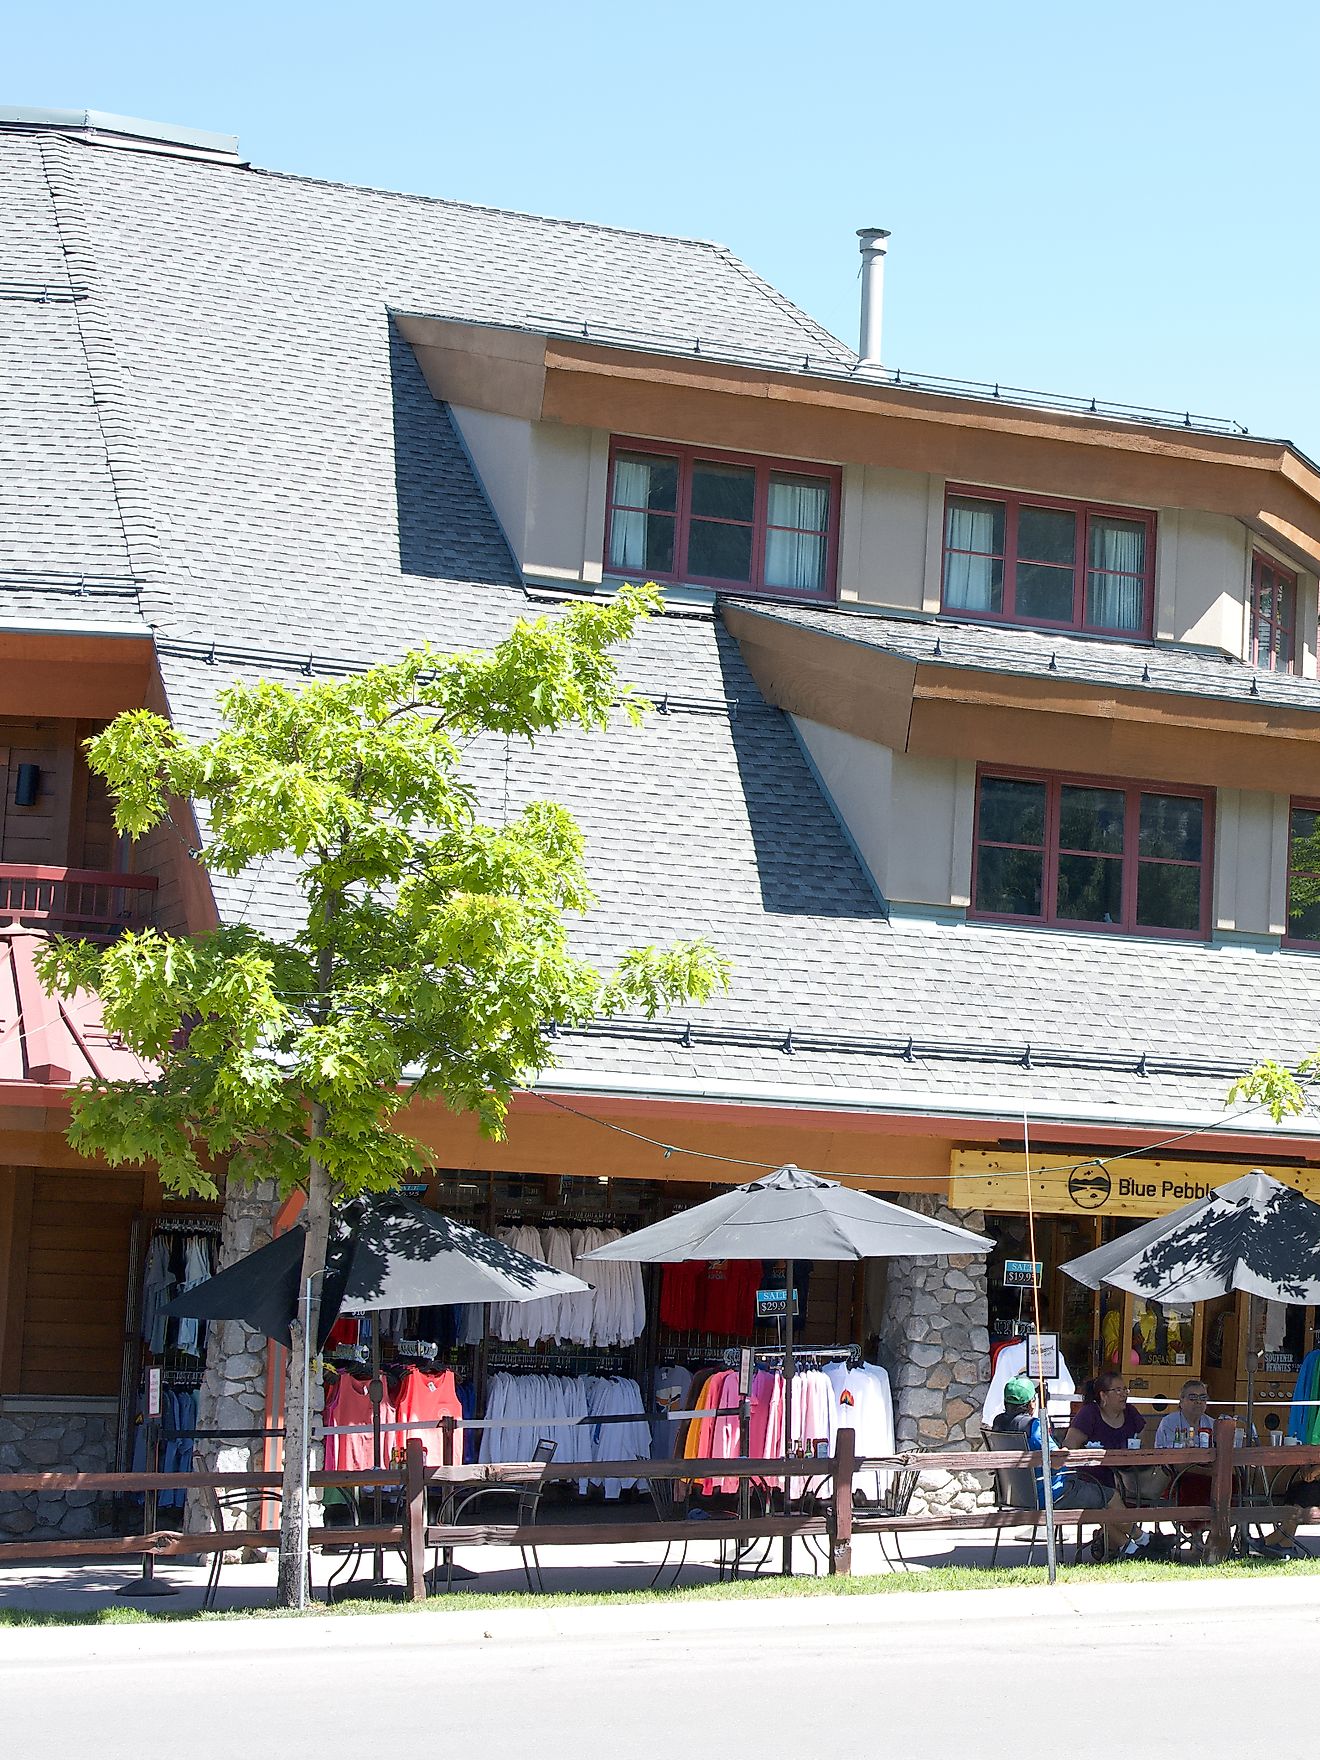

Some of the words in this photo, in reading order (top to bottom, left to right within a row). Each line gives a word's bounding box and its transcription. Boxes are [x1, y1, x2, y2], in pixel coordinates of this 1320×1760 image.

[1119, 1178, 1157, 1197] Blue
[1161, 1180, 1211, 1200] Pebbl
[761, 1301, 787, 1312] $29.9
